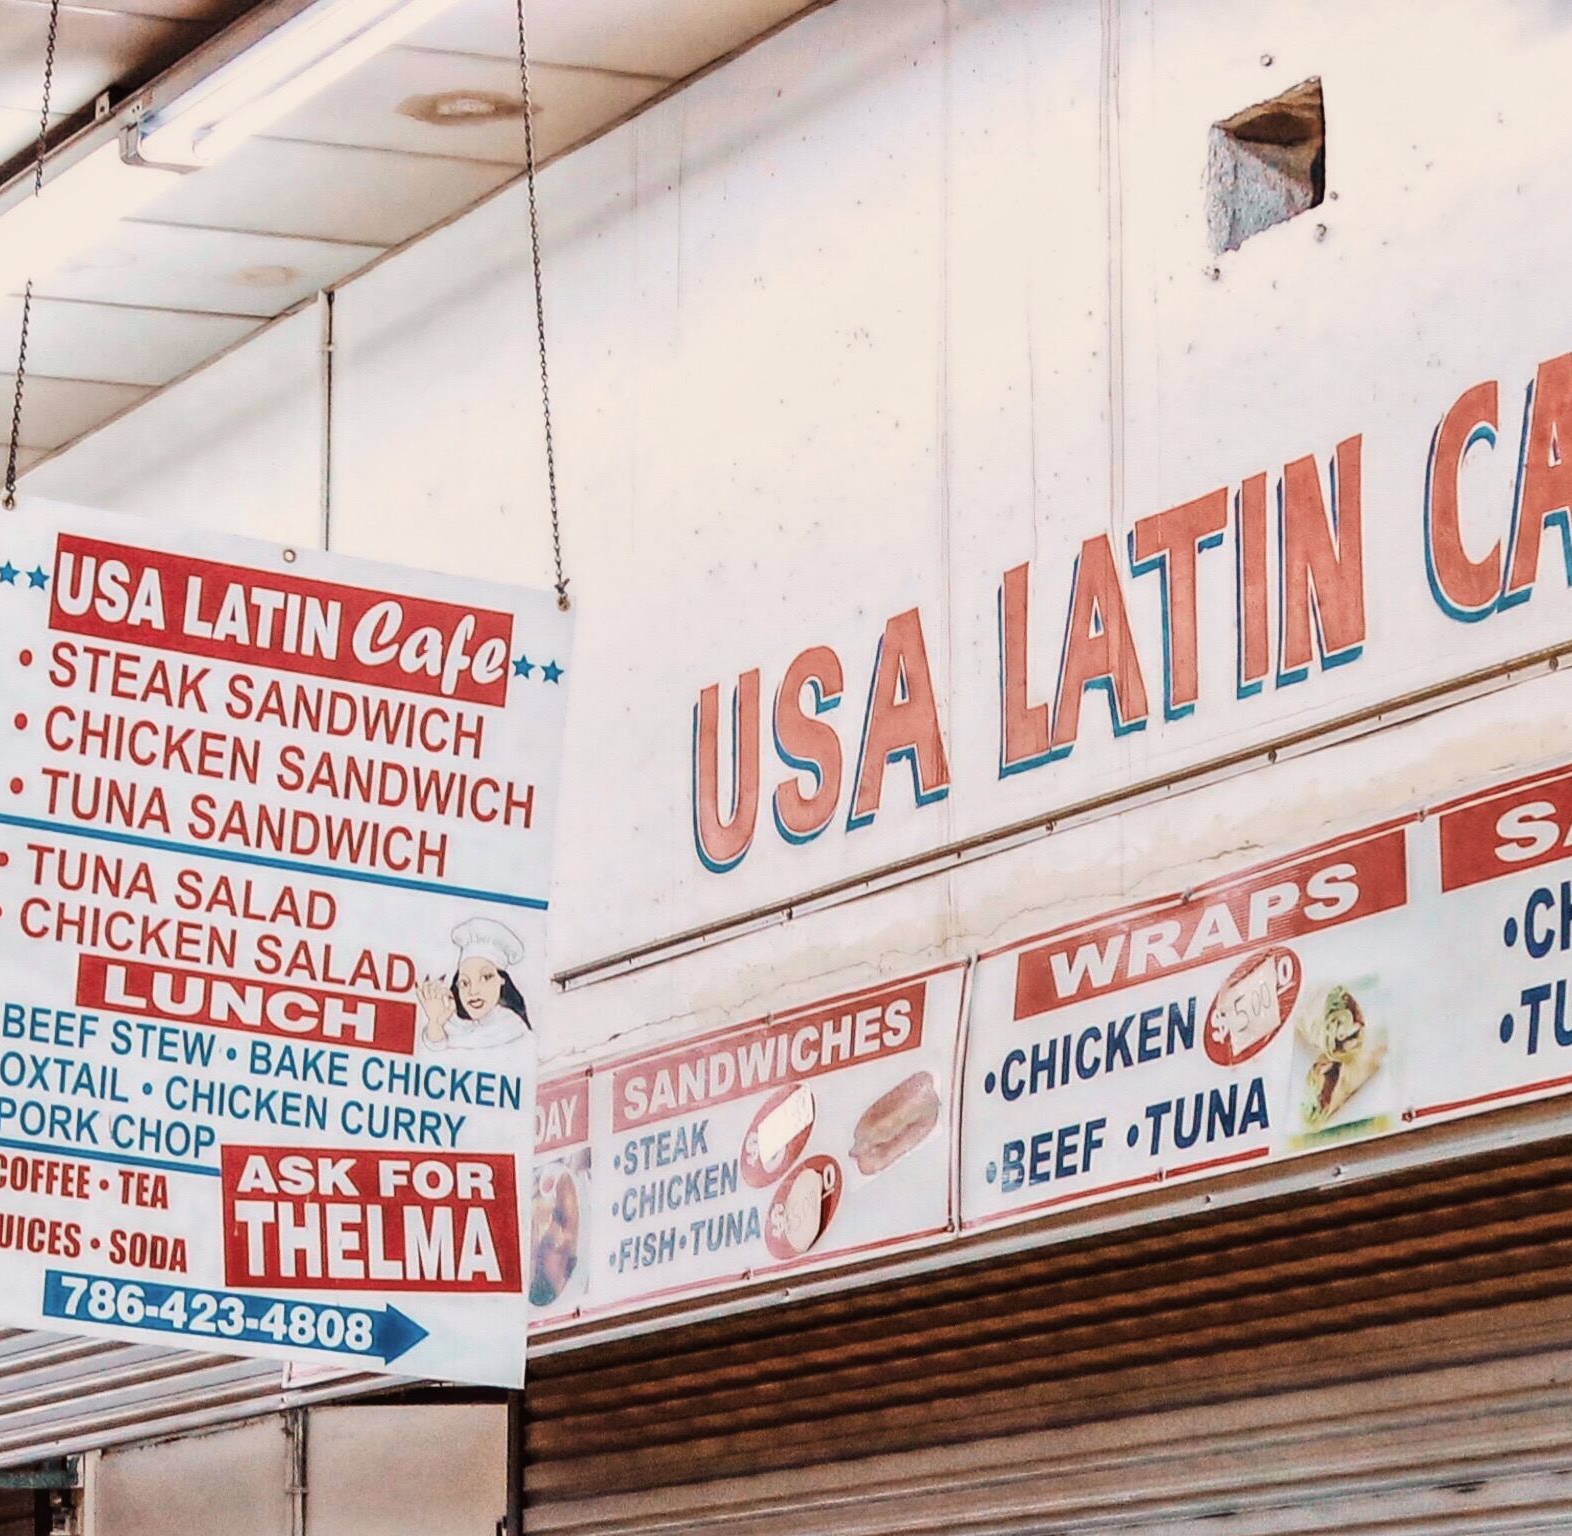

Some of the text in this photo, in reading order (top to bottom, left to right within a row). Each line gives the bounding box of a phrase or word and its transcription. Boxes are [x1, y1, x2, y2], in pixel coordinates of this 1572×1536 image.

[57, 552, 508, 696] USA LATIN Cafe
[693, 608, 952, 873] USA
[998, 433, 1367, 777] LATIN
[48, 641, 486, 760] STEAK SANDWICH
[43, 705, 534, 830] CHICKEN SANDWICH
[42, 768, 448, 877] TUNA SANDWICH
[27, 844, 338, 932] TUNA SALAD
[1049, 861, 1362, 998] WRAPS
[20, 898, 416, 994] CHICKEN SALAD
[103, 965, 376, 1042] LUNCH
[999, 995, 1199, 1103] CHICKEN
[0, 1051, 465, 1148] OXTAIL CHICKEN CURRY
[2, 1003, 520, 1110] BEEF STEW BAKE CHICKEN
[623, 999, 911, 1120] SANDWICHES
[112, 1115, 214, 1159] CHOP
[237, 1155, 494, 1200] ASK FOR
[622, 1120, 710, 1176] STEAK
[999, 1076, 1270, 1191] BEEF TUNA
[119, 1169, 168, 1209] TEA
[621, 1160, 738, 1222] CHICKEN
[109, 1229, 187, 1273] SODA
[233, 1200, 501, 1282] THELMA
[618, 1207, 760, 1274] FISH TUNA
[60, 1276, 374, 1351] 786-423-4808
